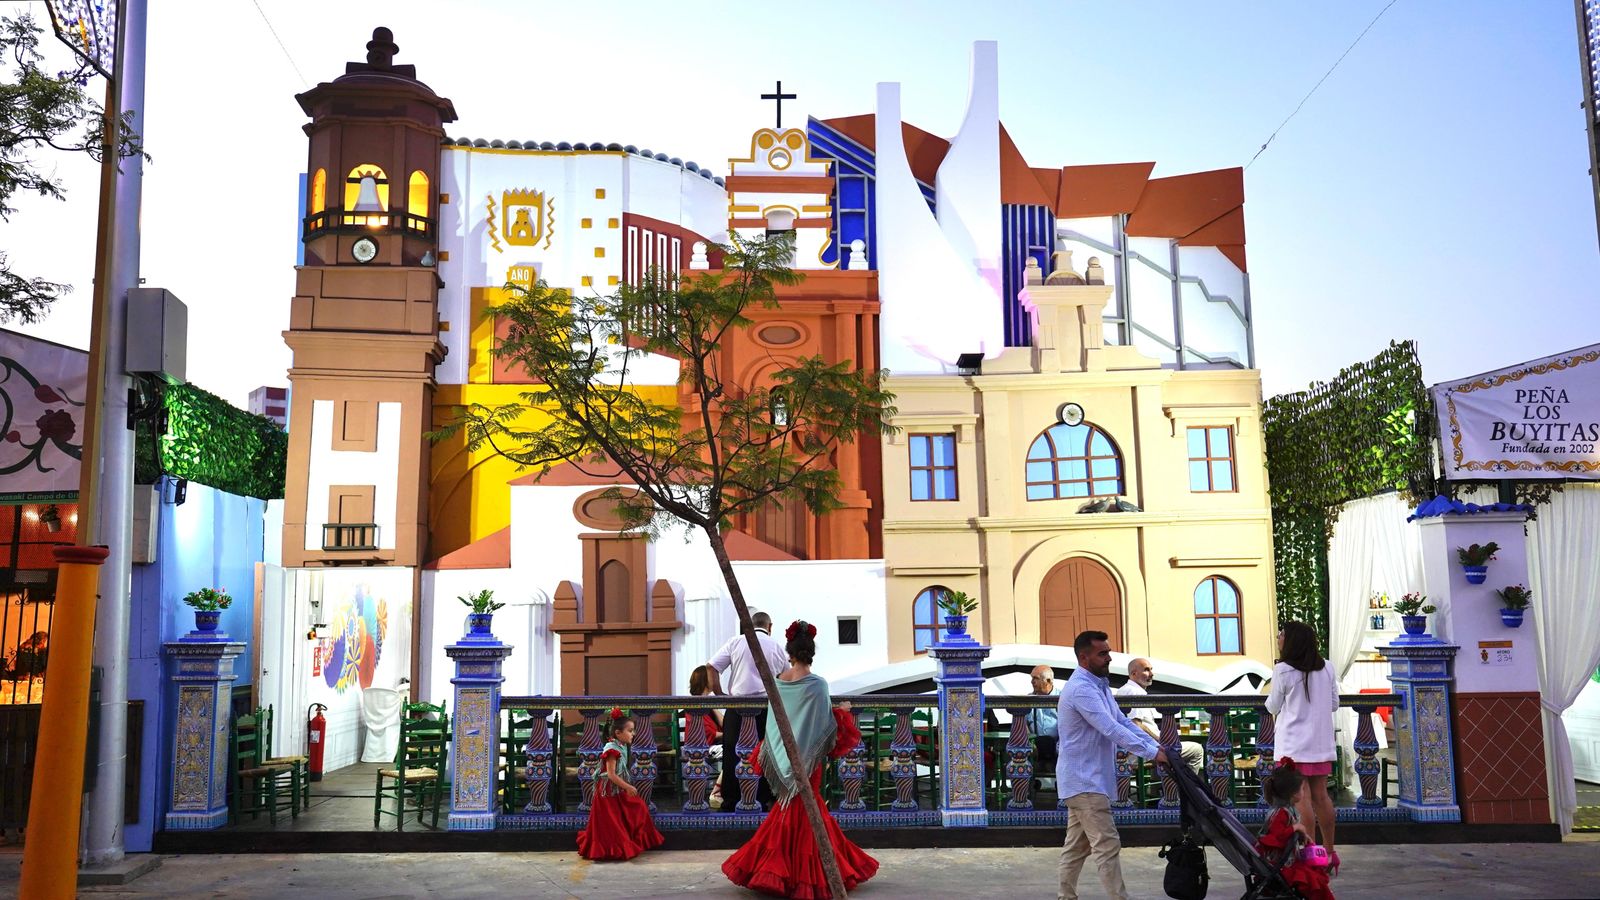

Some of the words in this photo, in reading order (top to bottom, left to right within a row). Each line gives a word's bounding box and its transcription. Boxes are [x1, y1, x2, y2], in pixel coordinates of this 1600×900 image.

[511, 268, 529, 281] AÑO
[1515, 386, 1570, 404] PEÑA
[1523, 405, 1561, 420] LOS
[1490, 422, 1599, 441] BUYITAS
[1502, 443, 1550, 453] Fundada
[1553, 446, 1566, 454] en
[1569, 444, 1594, 453] 2002
[27, 493, 54, 501] Campo
